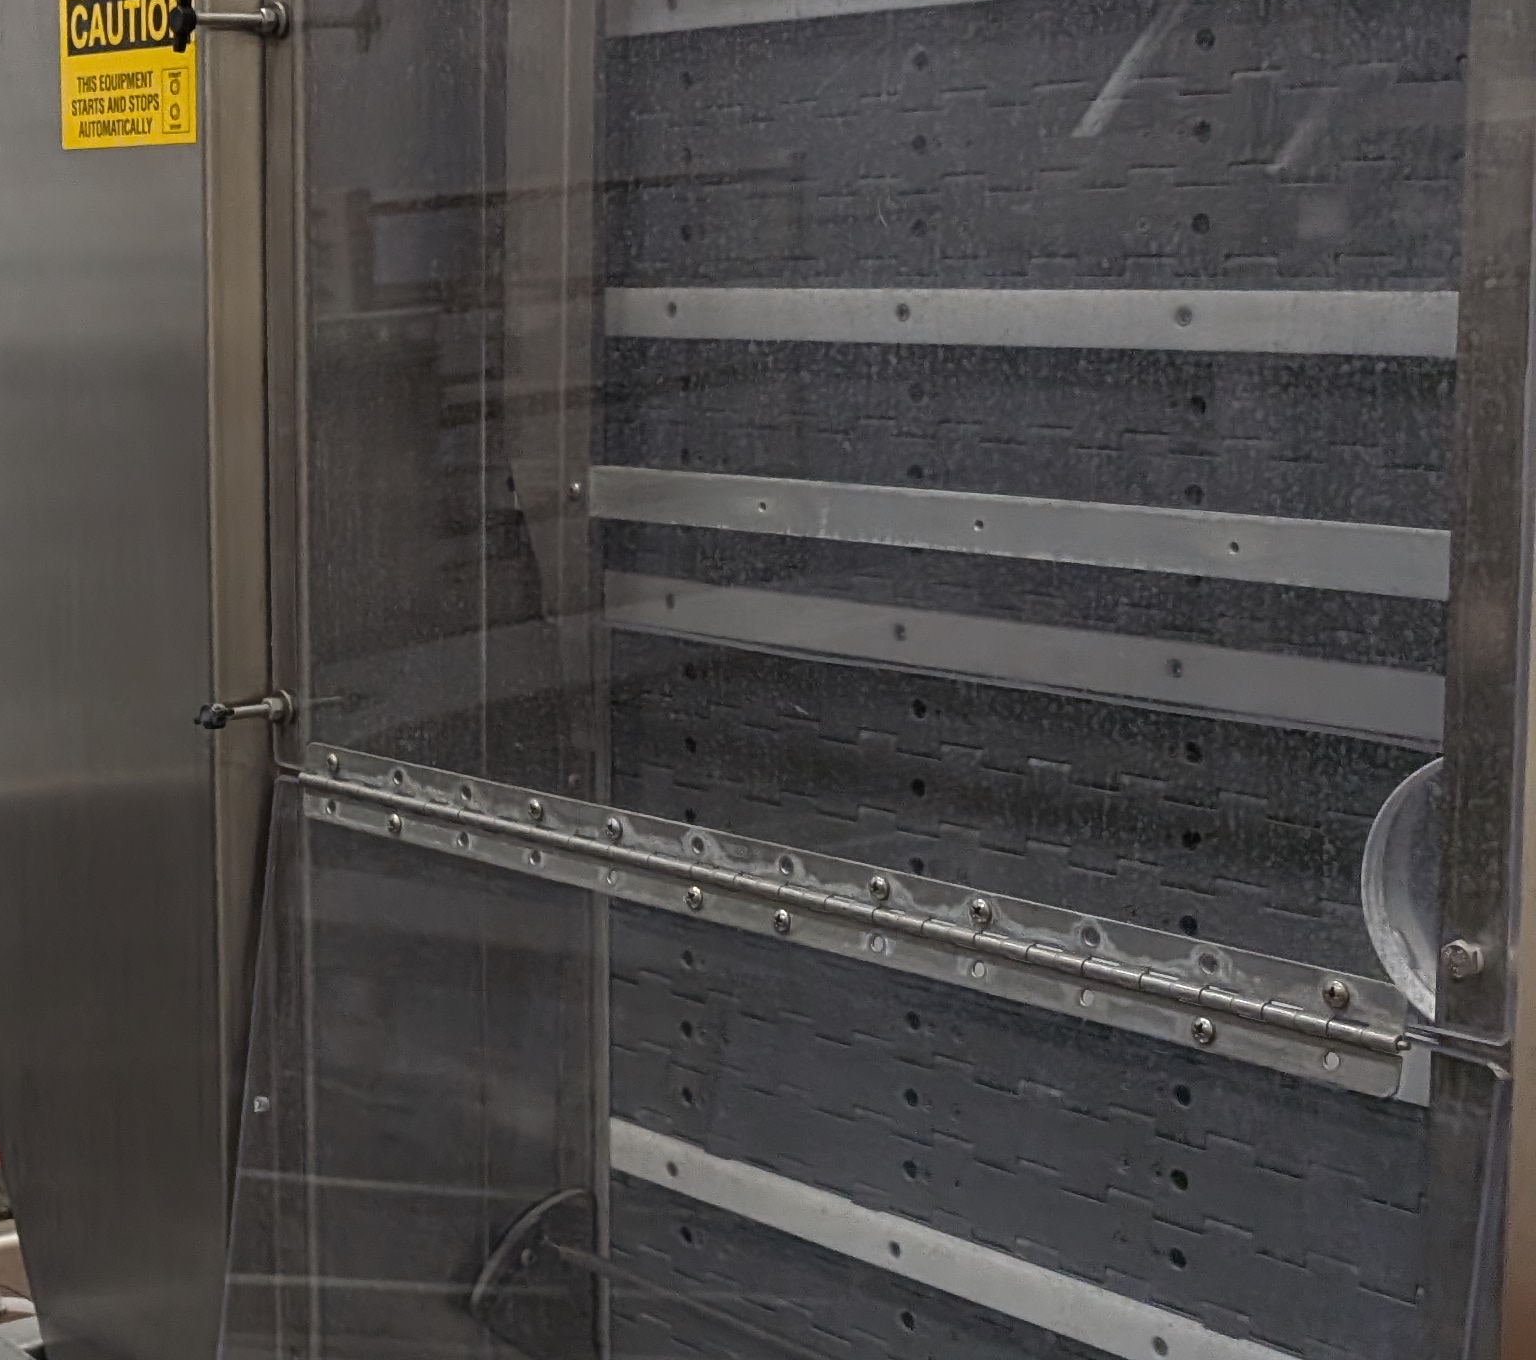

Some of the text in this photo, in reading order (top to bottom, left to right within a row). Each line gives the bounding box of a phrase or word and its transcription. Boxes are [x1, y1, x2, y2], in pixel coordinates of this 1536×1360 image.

[77, 70, 154, 94] THIS EQUIPMENT
[72, 93, 160, 116] STARTS AND STOPS
[78, 117, 153, 138] AUTOMATICALLY
